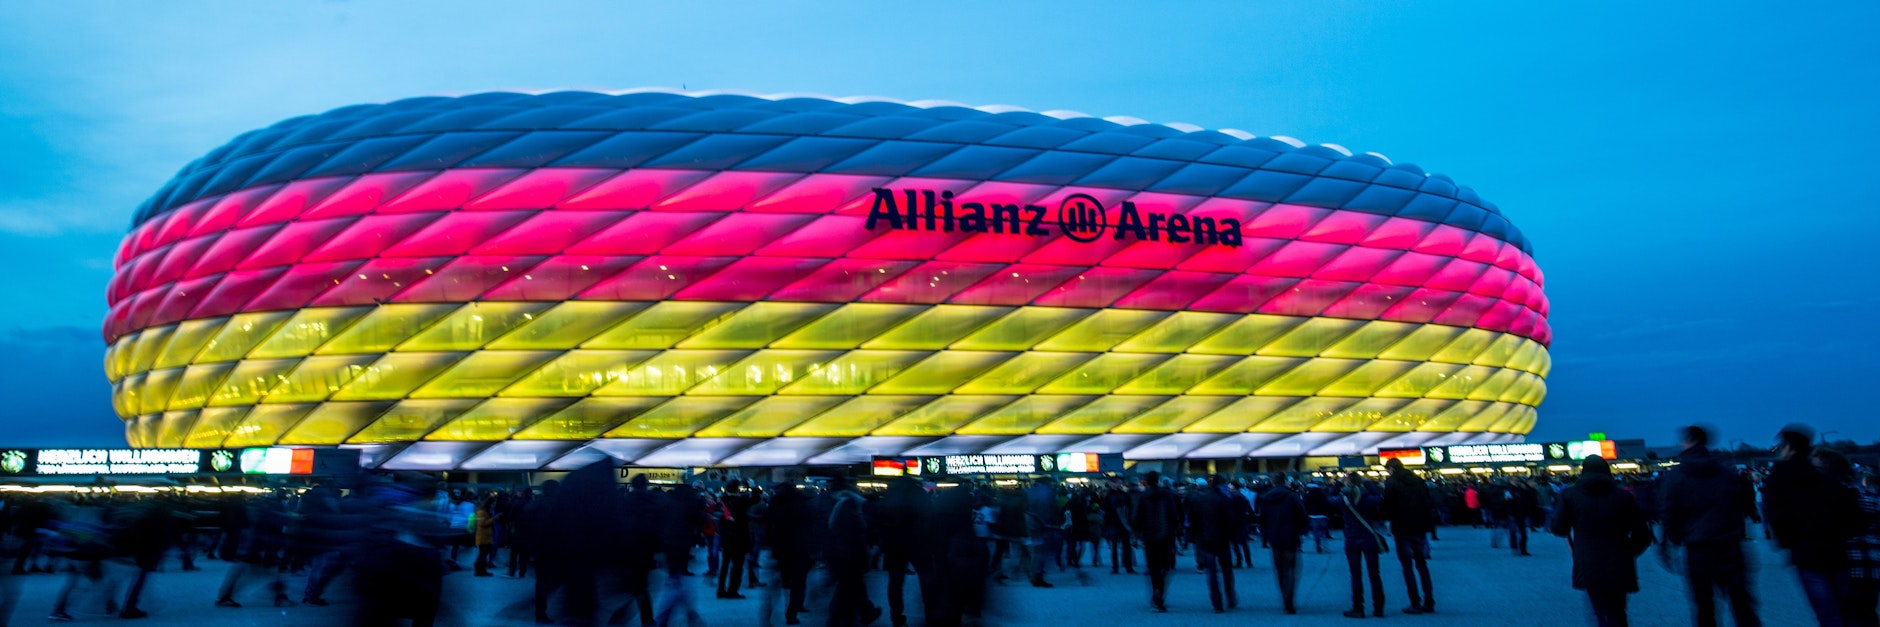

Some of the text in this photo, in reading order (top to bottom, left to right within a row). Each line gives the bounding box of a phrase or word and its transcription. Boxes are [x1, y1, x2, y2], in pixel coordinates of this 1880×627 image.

[865, 188, 1243, 247] Allianz Arena
[37, 450, 200, 463] HERZLICH WILLKOMMEN
[621, 467, 628, 478] D
